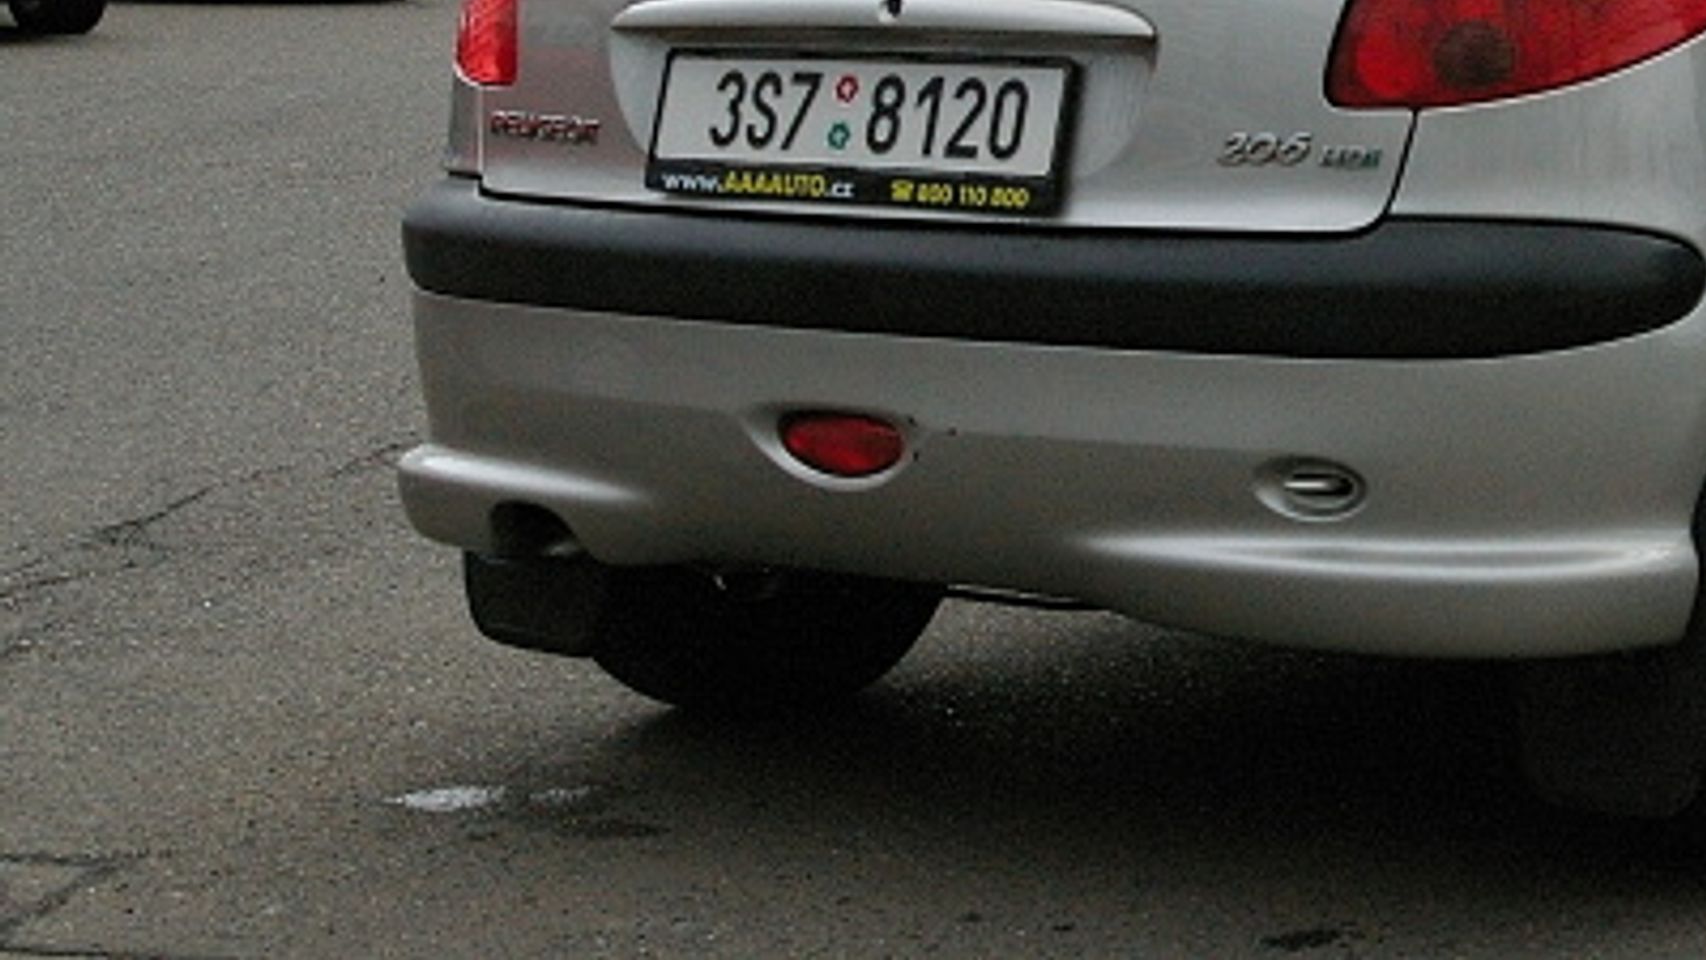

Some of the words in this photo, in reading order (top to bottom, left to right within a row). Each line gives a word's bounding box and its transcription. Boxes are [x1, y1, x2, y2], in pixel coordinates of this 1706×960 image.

[708, 68, 825, 152] 3S7
[866, 74, 1030, 160] 8120
[1217, 130, 1312, 168] 206
